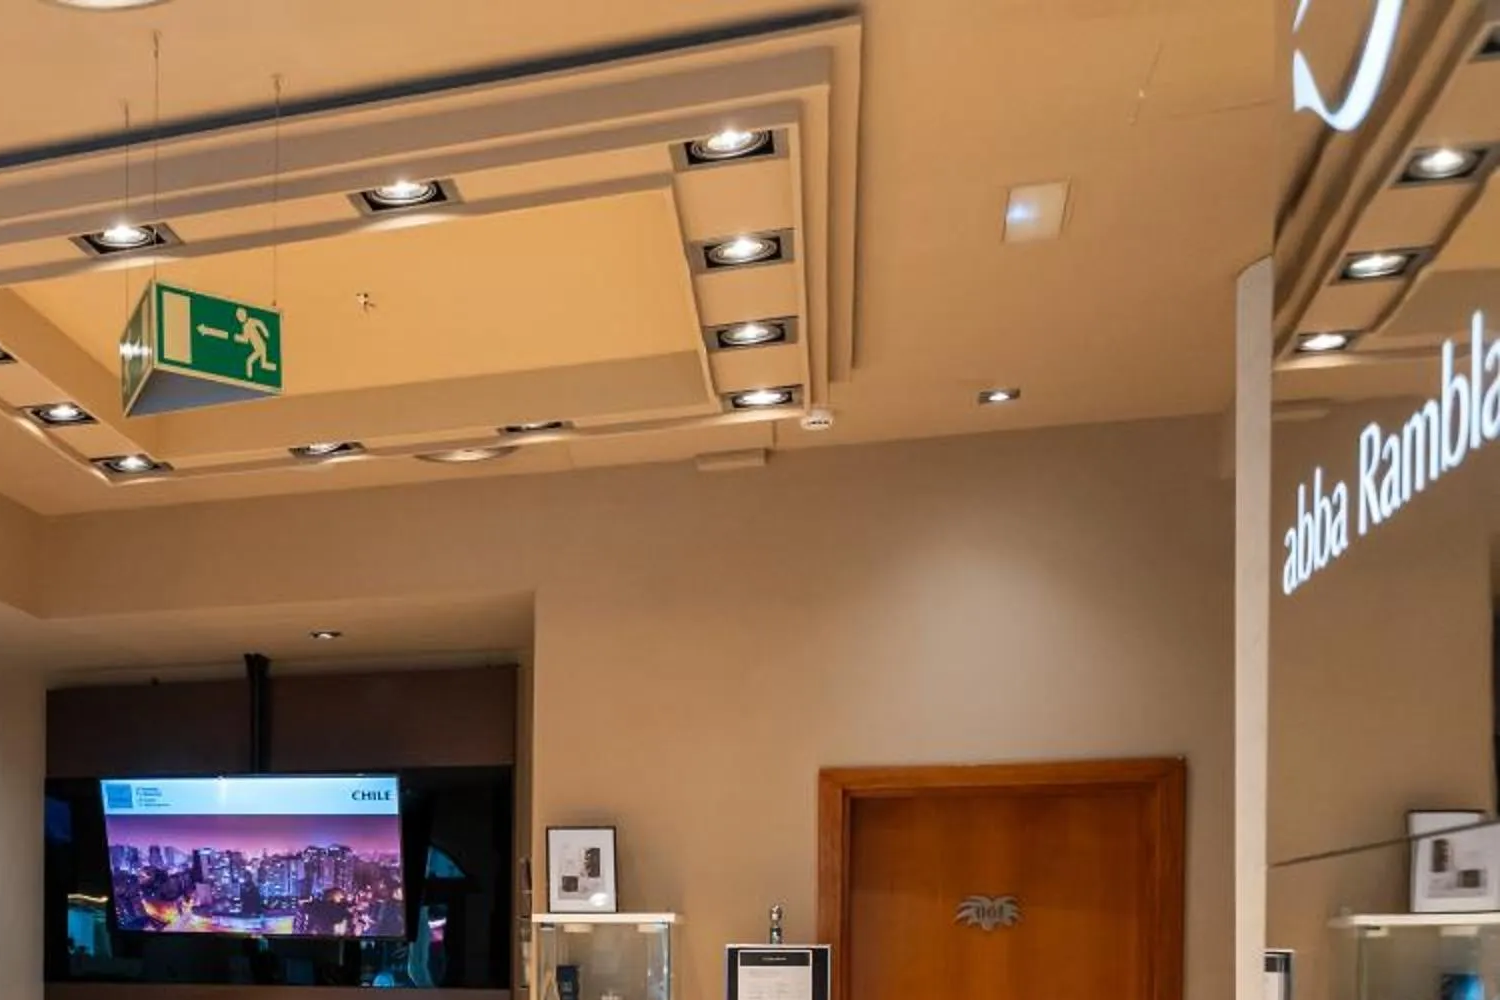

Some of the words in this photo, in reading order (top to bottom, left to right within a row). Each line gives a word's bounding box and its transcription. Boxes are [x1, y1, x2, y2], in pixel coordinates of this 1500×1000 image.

[1283, 466, 1348, 595] abba
[1358, 309, 1500, 536] Rambla
[351, 789, 392, 801] CHILE
